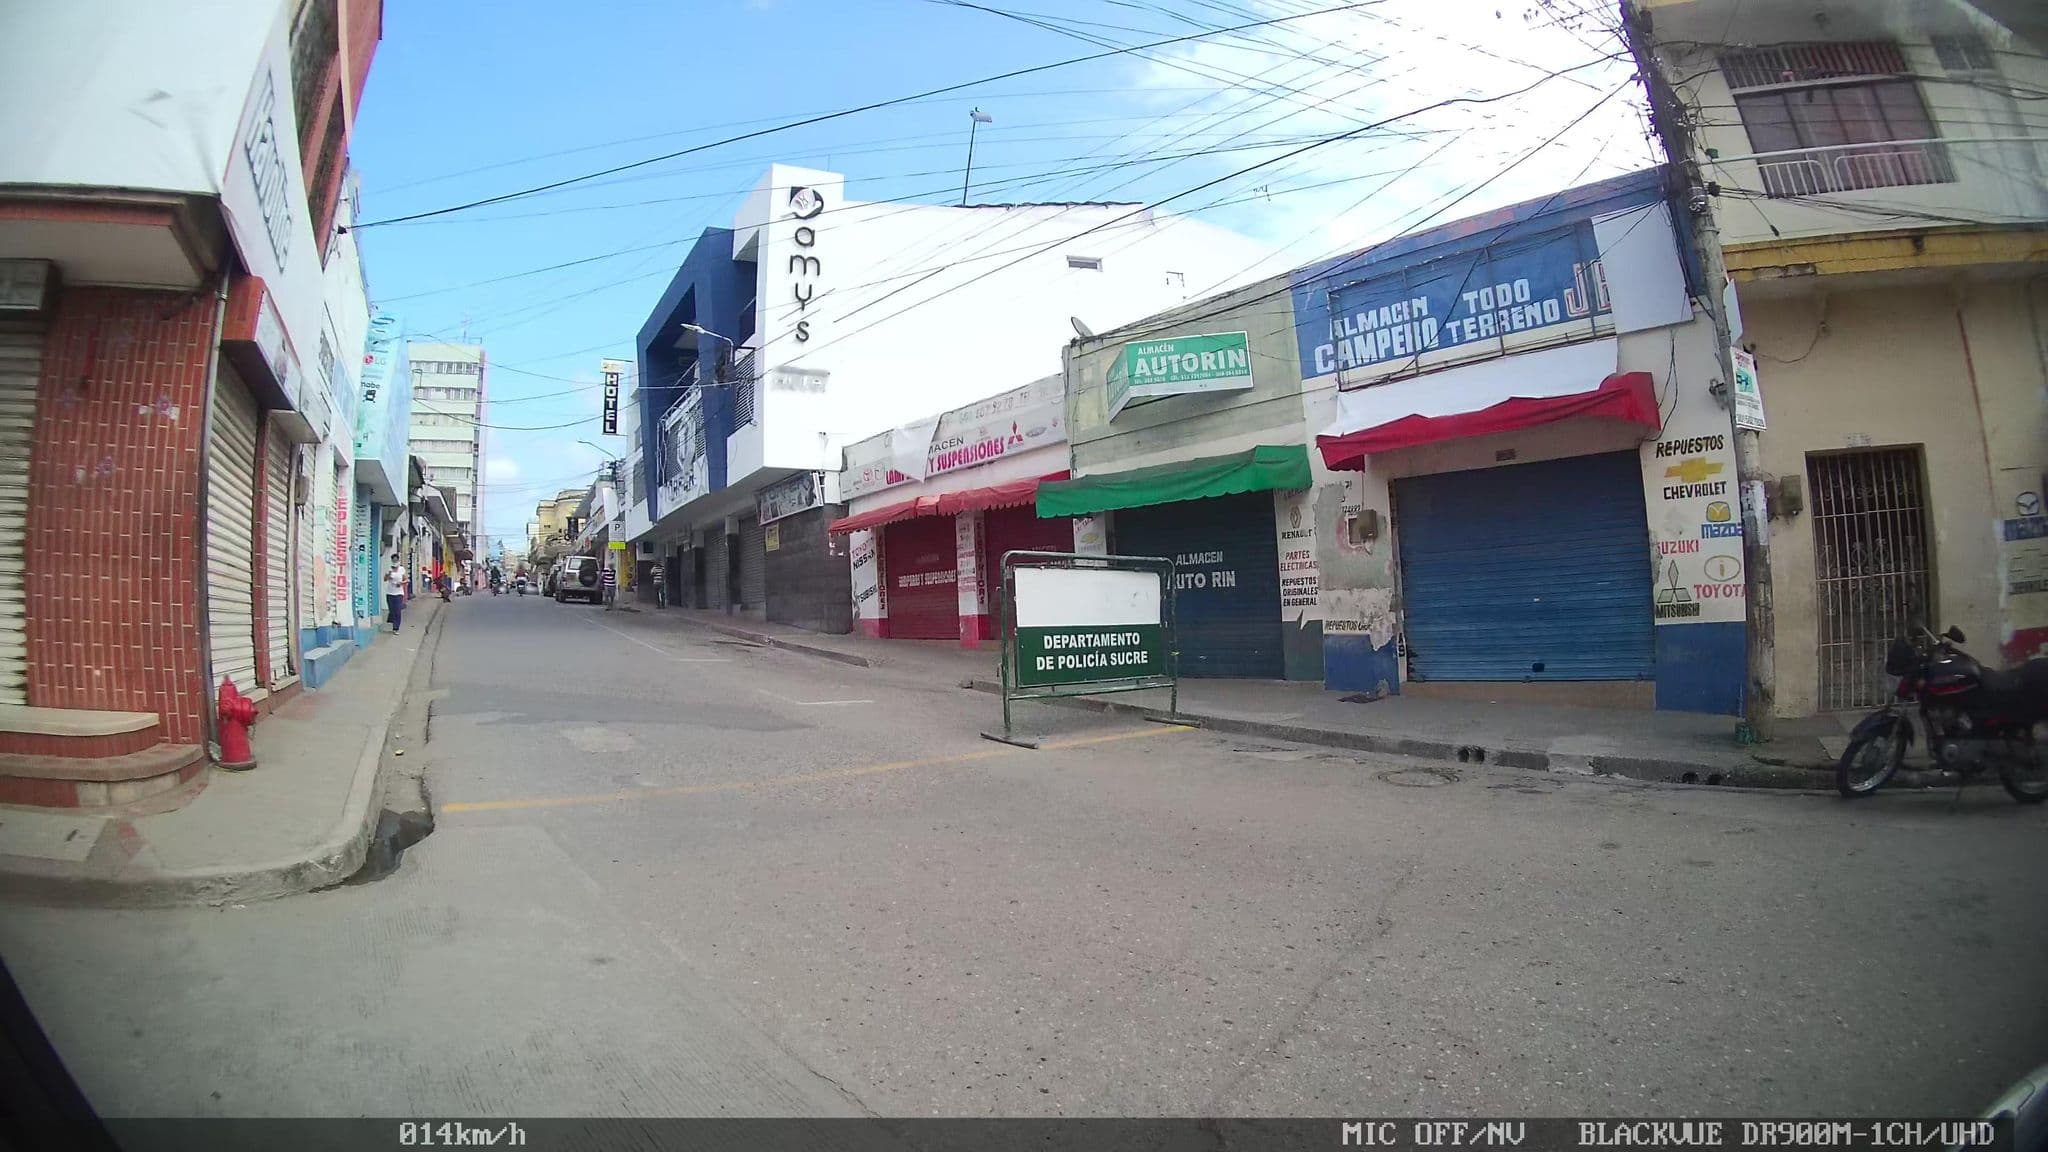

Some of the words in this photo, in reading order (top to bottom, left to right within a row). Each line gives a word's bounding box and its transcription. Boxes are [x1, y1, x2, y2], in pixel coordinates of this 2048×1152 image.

[1329, 296, 1428, 340] ALMACEN
[1462, 278, 1530, 314] TODO
[1446, 298, 1559, 343] TERRENO
[1135, 349, 1246, 377] AUTORIN
[605, 374, 617, 433] HOTEL
[937, 437, 1004, 472] SUSPENSIONES
[1656, 435, 1724, 458] REPUESTOS
[1663, 481, 1726, 500] CHEVROLET
[1175, 551, 1223, 566] ALMACEN
[1285, 551, 1310, 560] PARTES
[1212, 571, 1236, 588] RIN
[1044, 632, 1140, 649] DEPARTAMENTO
[1036, 656, 1055, 670] DE
[1058, 651, 1107, 669] POLICÍA
[1110, 651, 1148, 666] SUCRE
